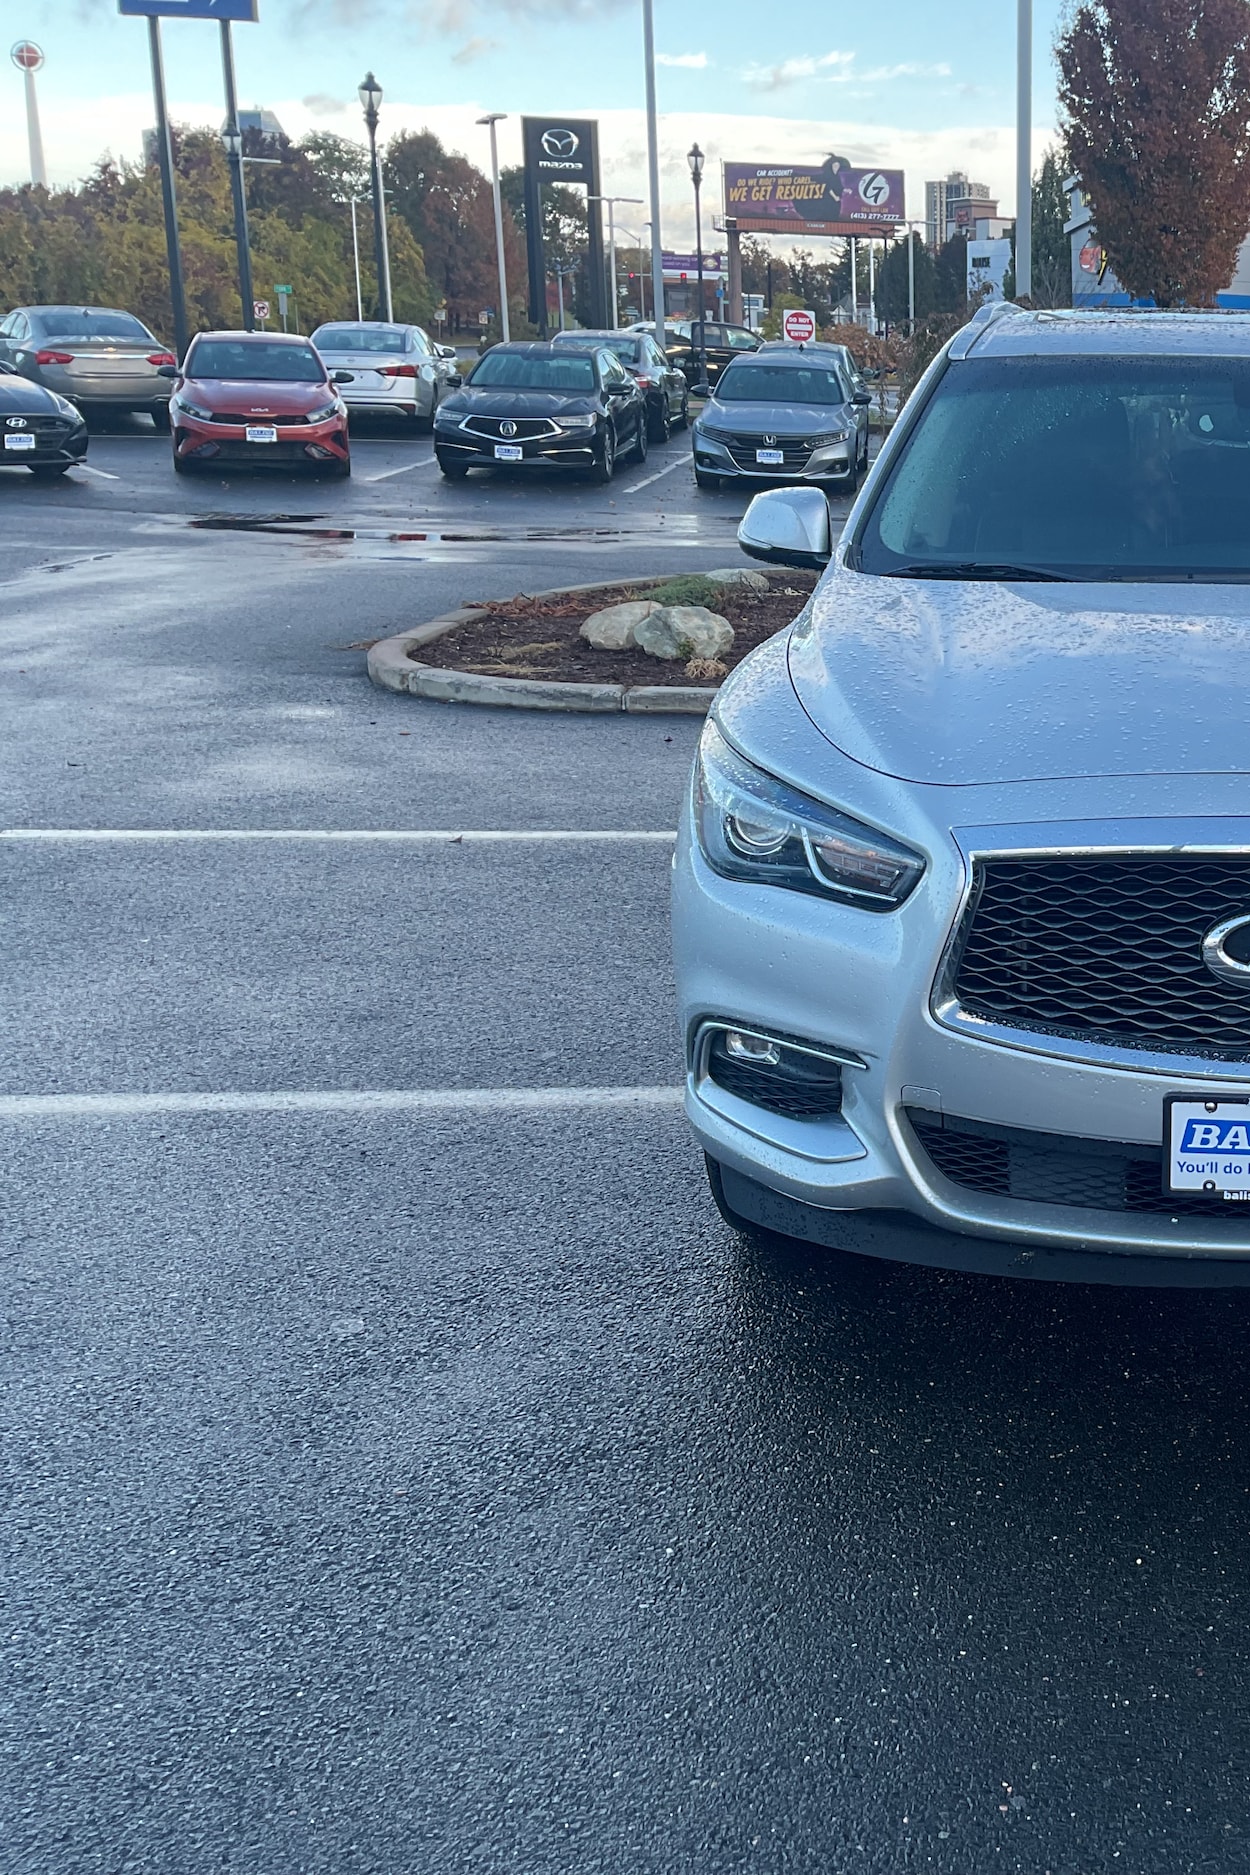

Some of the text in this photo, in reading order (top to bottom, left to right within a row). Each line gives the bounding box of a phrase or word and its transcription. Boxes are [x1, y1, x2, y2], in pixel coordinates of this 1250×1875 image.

[539, 161, 583, 169] mazda
[748, 178, 757, 186] WE
[729, 183, 826, 201] WE GET RESULTS!
[1177, 1161, 1218, 1174] You'll
[1223, 1162, 1243, 1174] do
